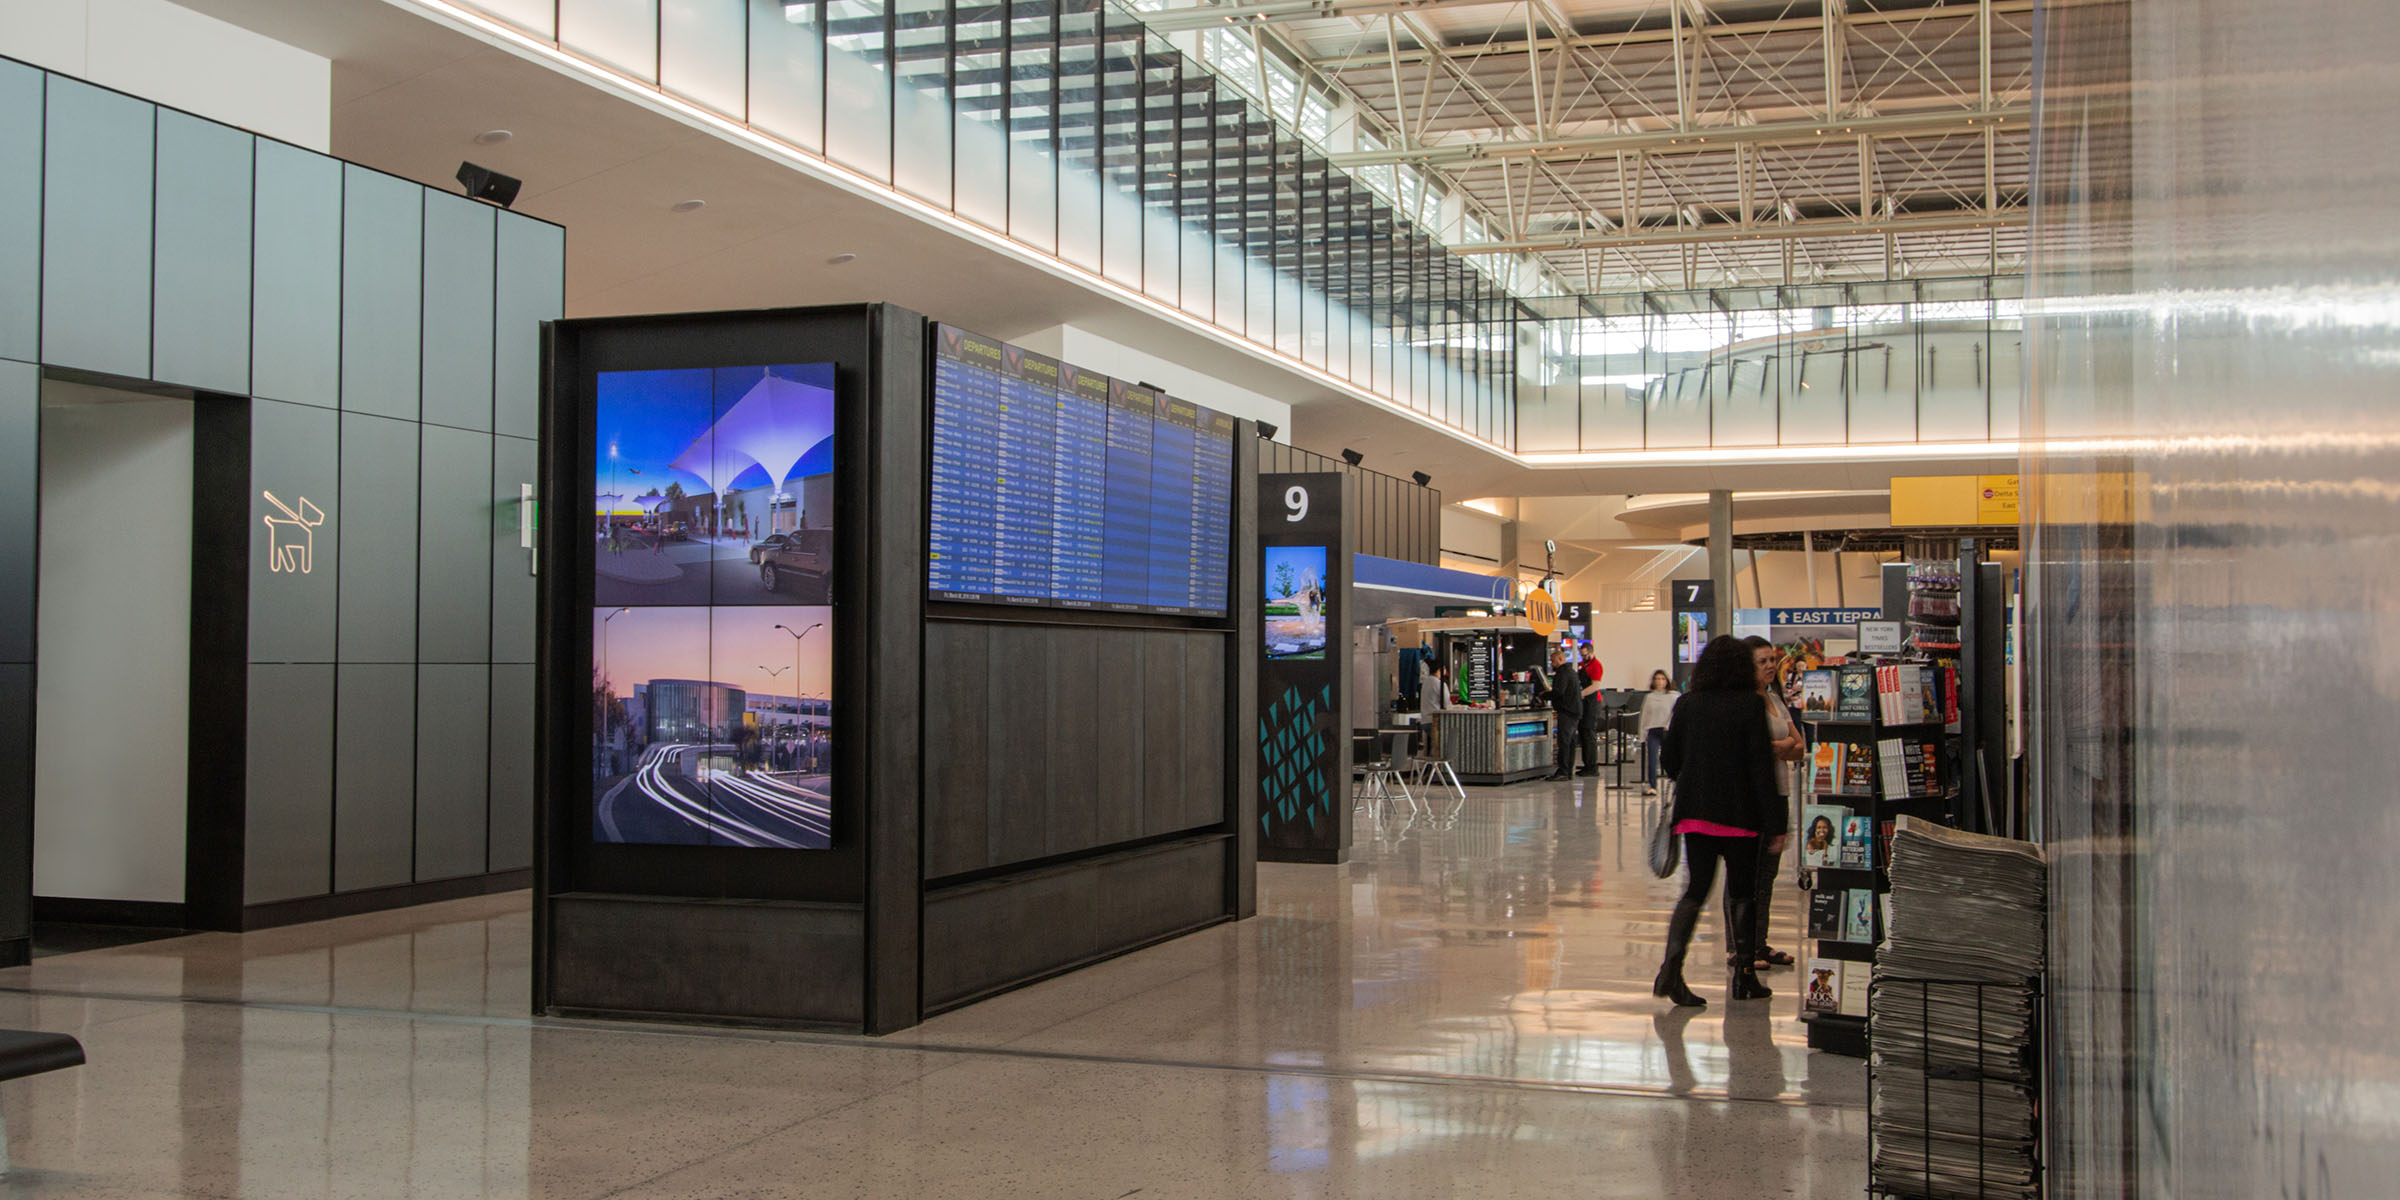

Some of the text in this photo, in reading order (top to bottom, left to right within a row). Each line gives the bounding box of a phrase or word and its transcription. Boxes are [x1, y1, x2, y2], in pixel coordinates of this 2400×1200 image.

[963, 339, 1001, 361] DEPARTURES
[1284, 486, 1309, 522] 9
[1687, 585, 1699, 602] 7
[1570, 606, 1579, 619] 5
[1792, 611, 1830, 624] EAST
